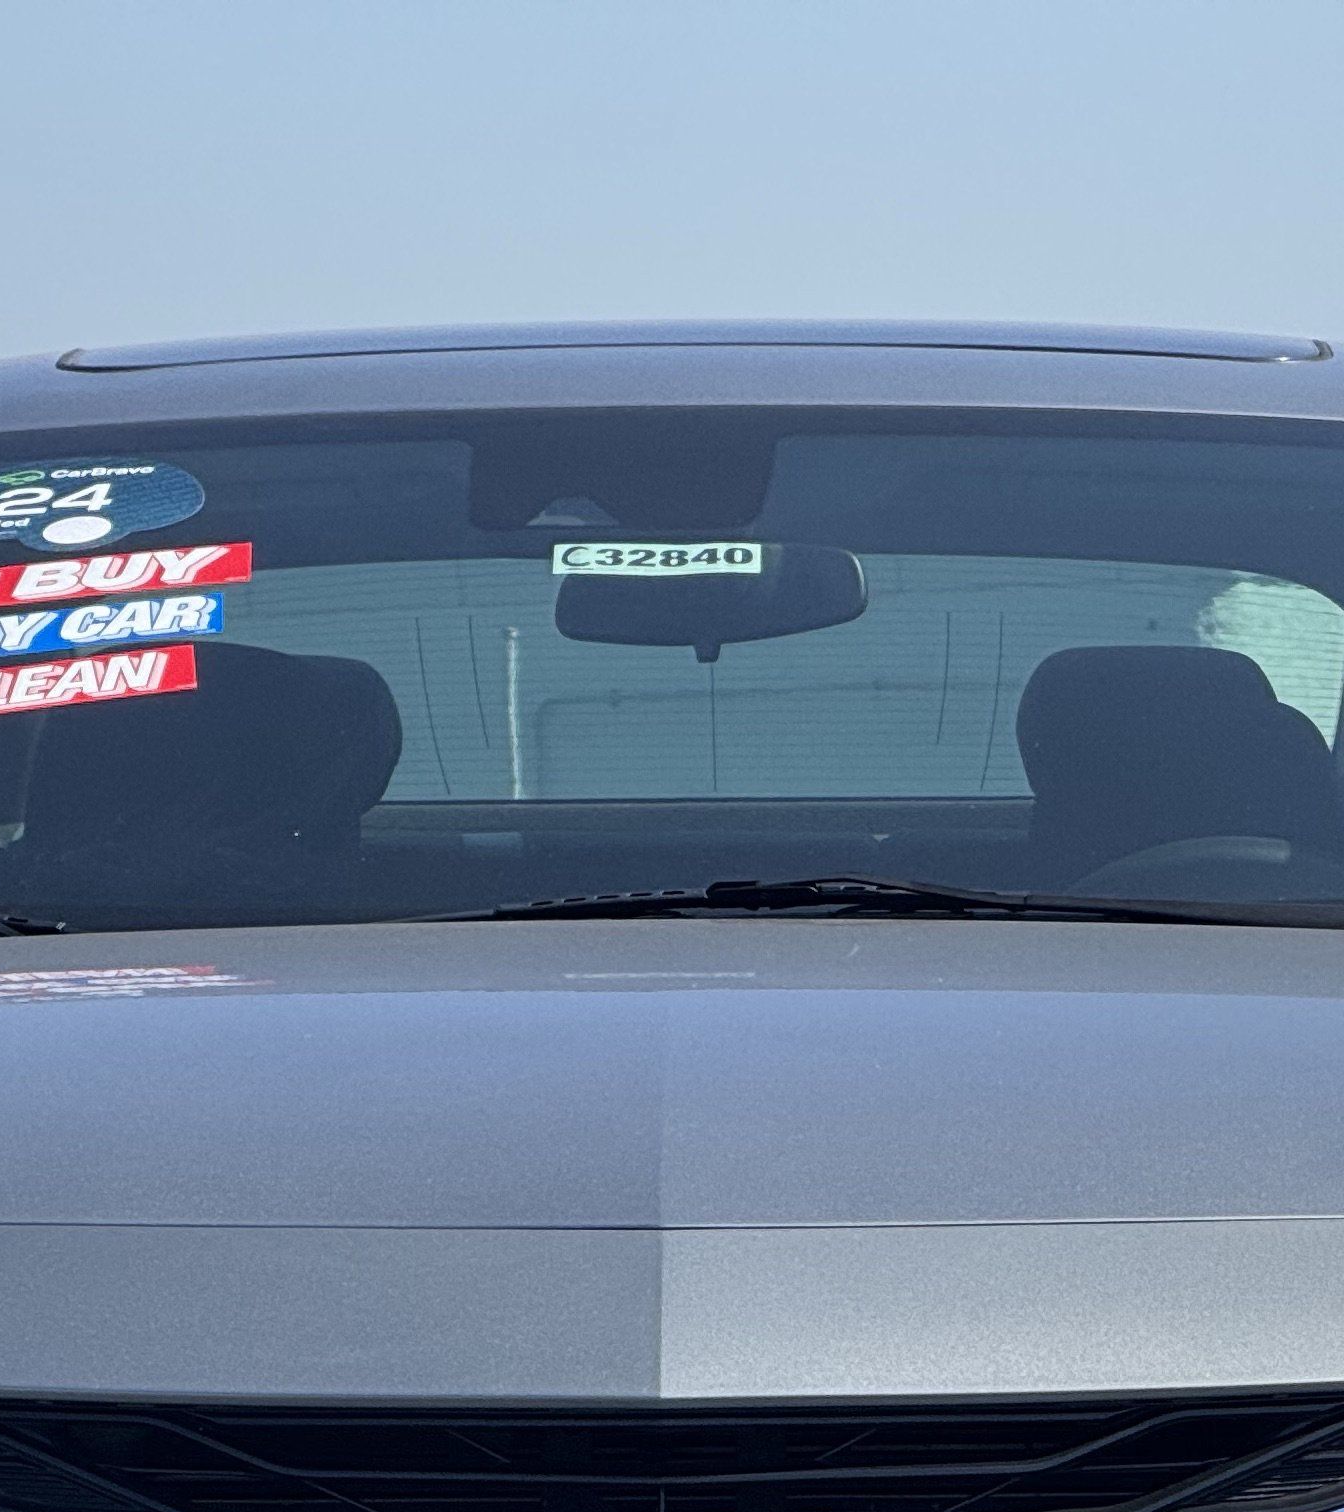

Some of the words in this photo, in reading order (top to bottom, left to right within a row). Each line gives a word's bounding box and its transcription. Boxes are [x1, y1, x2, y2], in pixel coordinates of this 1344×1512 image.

[12, 546, 229, 600] BUY
[561, 546, 754, 568] C32840
[60, 595, 216, 642] CAR
